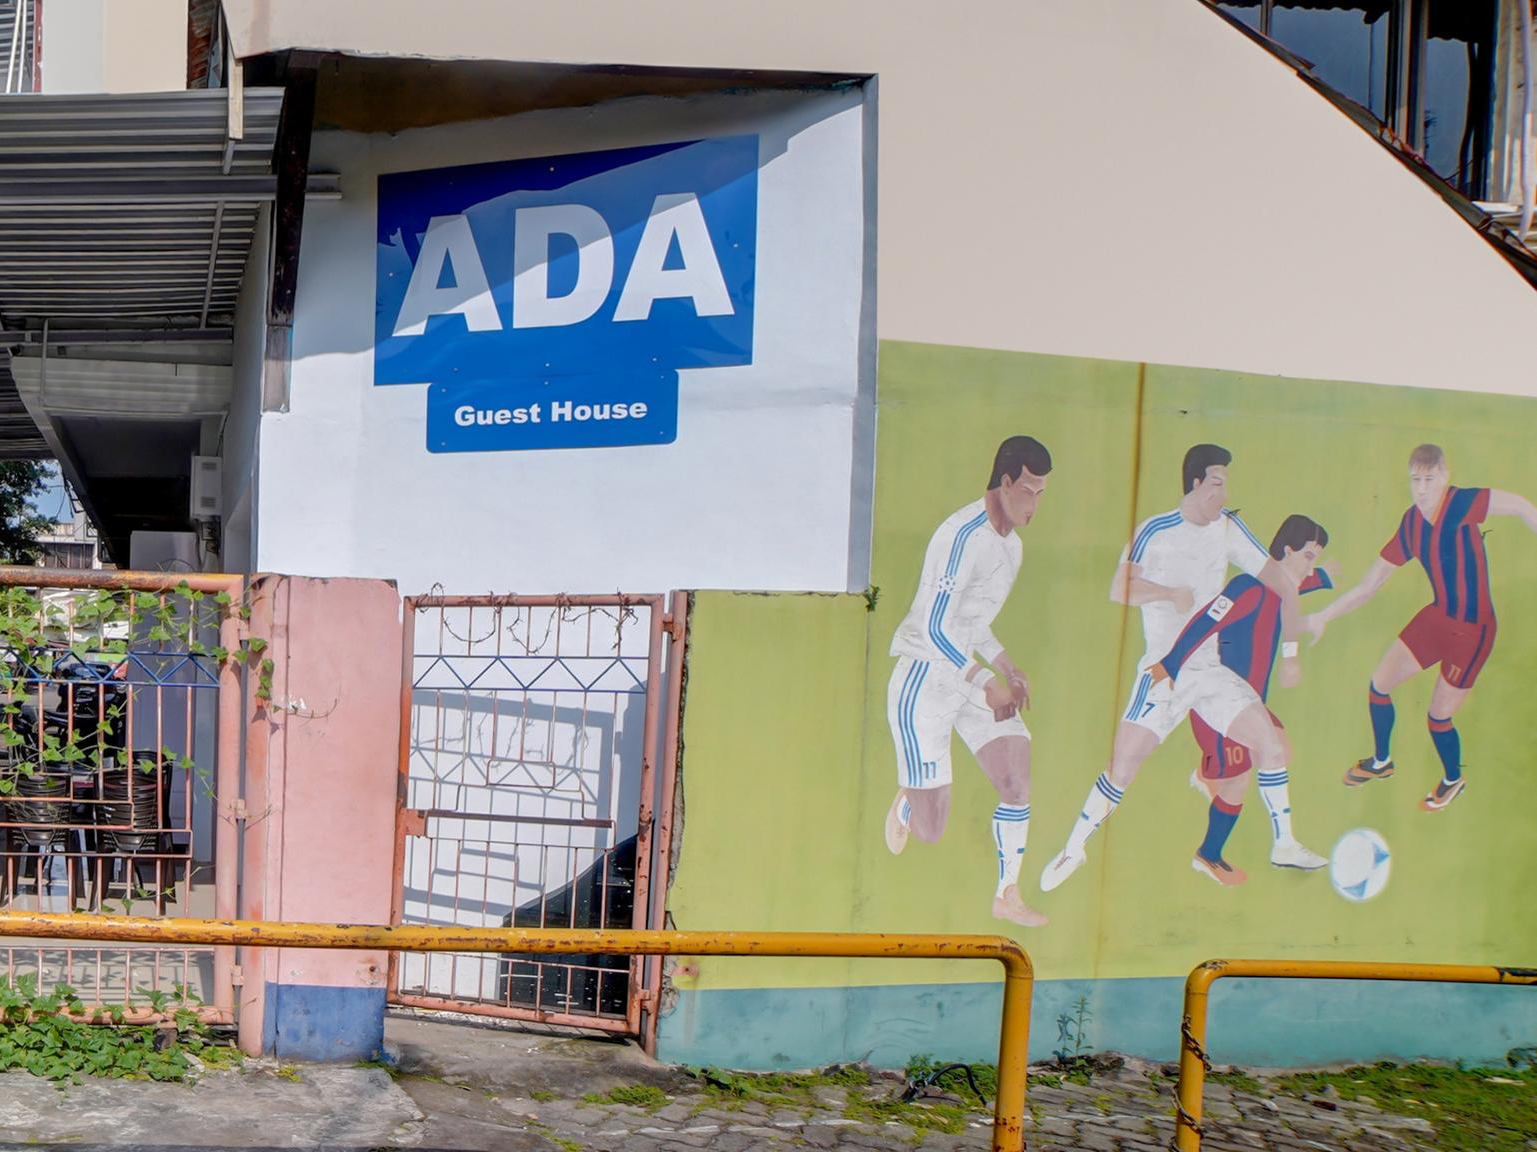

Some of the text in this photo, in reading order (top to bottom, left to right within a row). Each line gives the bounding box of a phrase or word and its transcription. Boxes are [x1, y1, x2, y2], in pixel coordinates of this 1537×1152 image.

[391, 191, 736, 337] ADA
[454, 400, 648, 427] Guest House
[1141, 701, 1156, 718] 7
[1224, 745, 1244, 766] 10
[922, 760, 937, 779] 11
